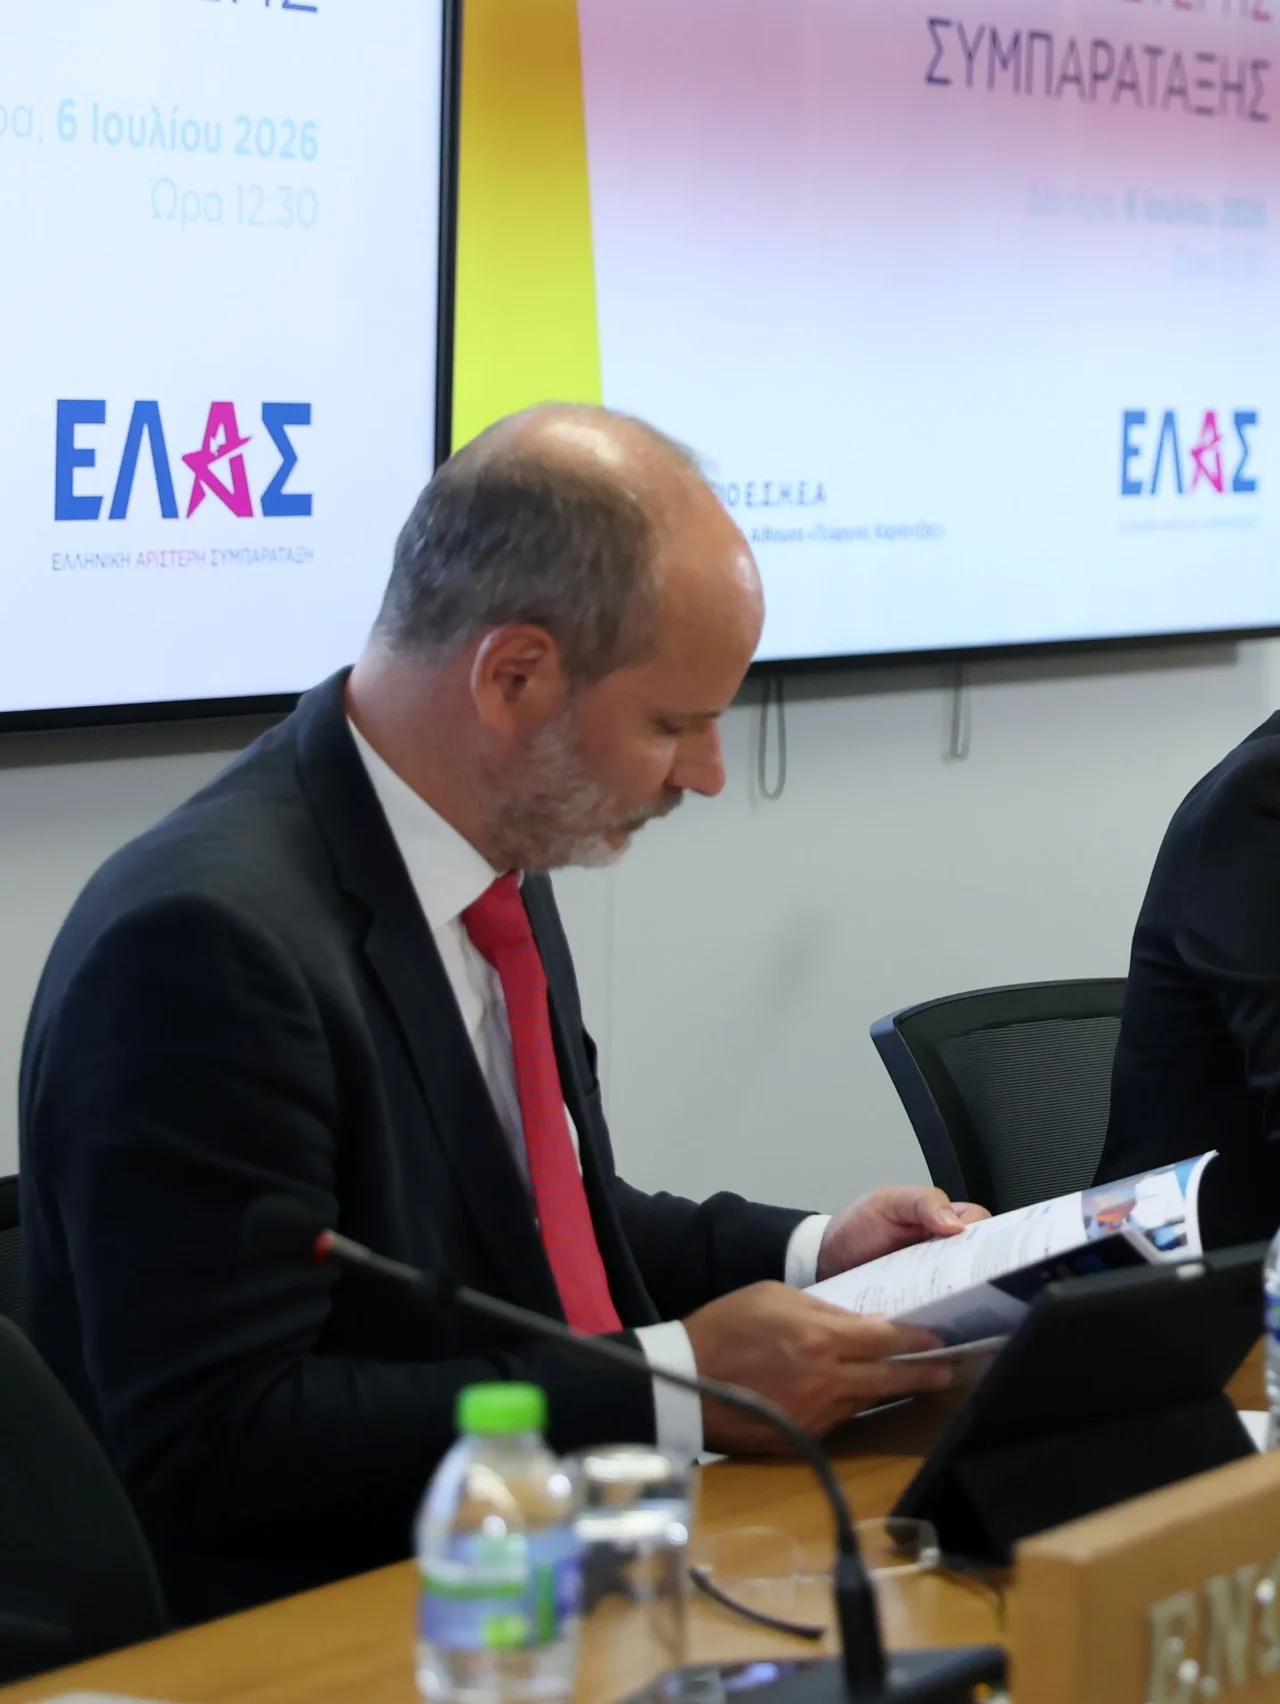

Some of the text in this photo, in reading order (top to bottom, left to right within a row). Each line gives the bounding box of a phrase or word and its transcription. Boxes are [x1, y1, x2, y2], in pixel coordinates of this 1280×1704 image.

[924, 16, 1272, 123] ΣΥΜΠΑΡΑΤΑΞΗΣ
[57, 97, 78, 142] 6
[91, 101, 223, 154] Ιουλίου
[234, 114, 319, 162] 2026
[235, 183, 319, 229] 12:30
[54, 399, 313, 521] ΕΛΑΣ
[1120, 410, 1257, 496] ΕΛΑΣ
[51, 545, 315, 572] ΕΛΛΗΝΙΚΗ ΑΡΙΣΤΕΡΗ ΣΥΜΠΑΡΑΤΑΞΗ
